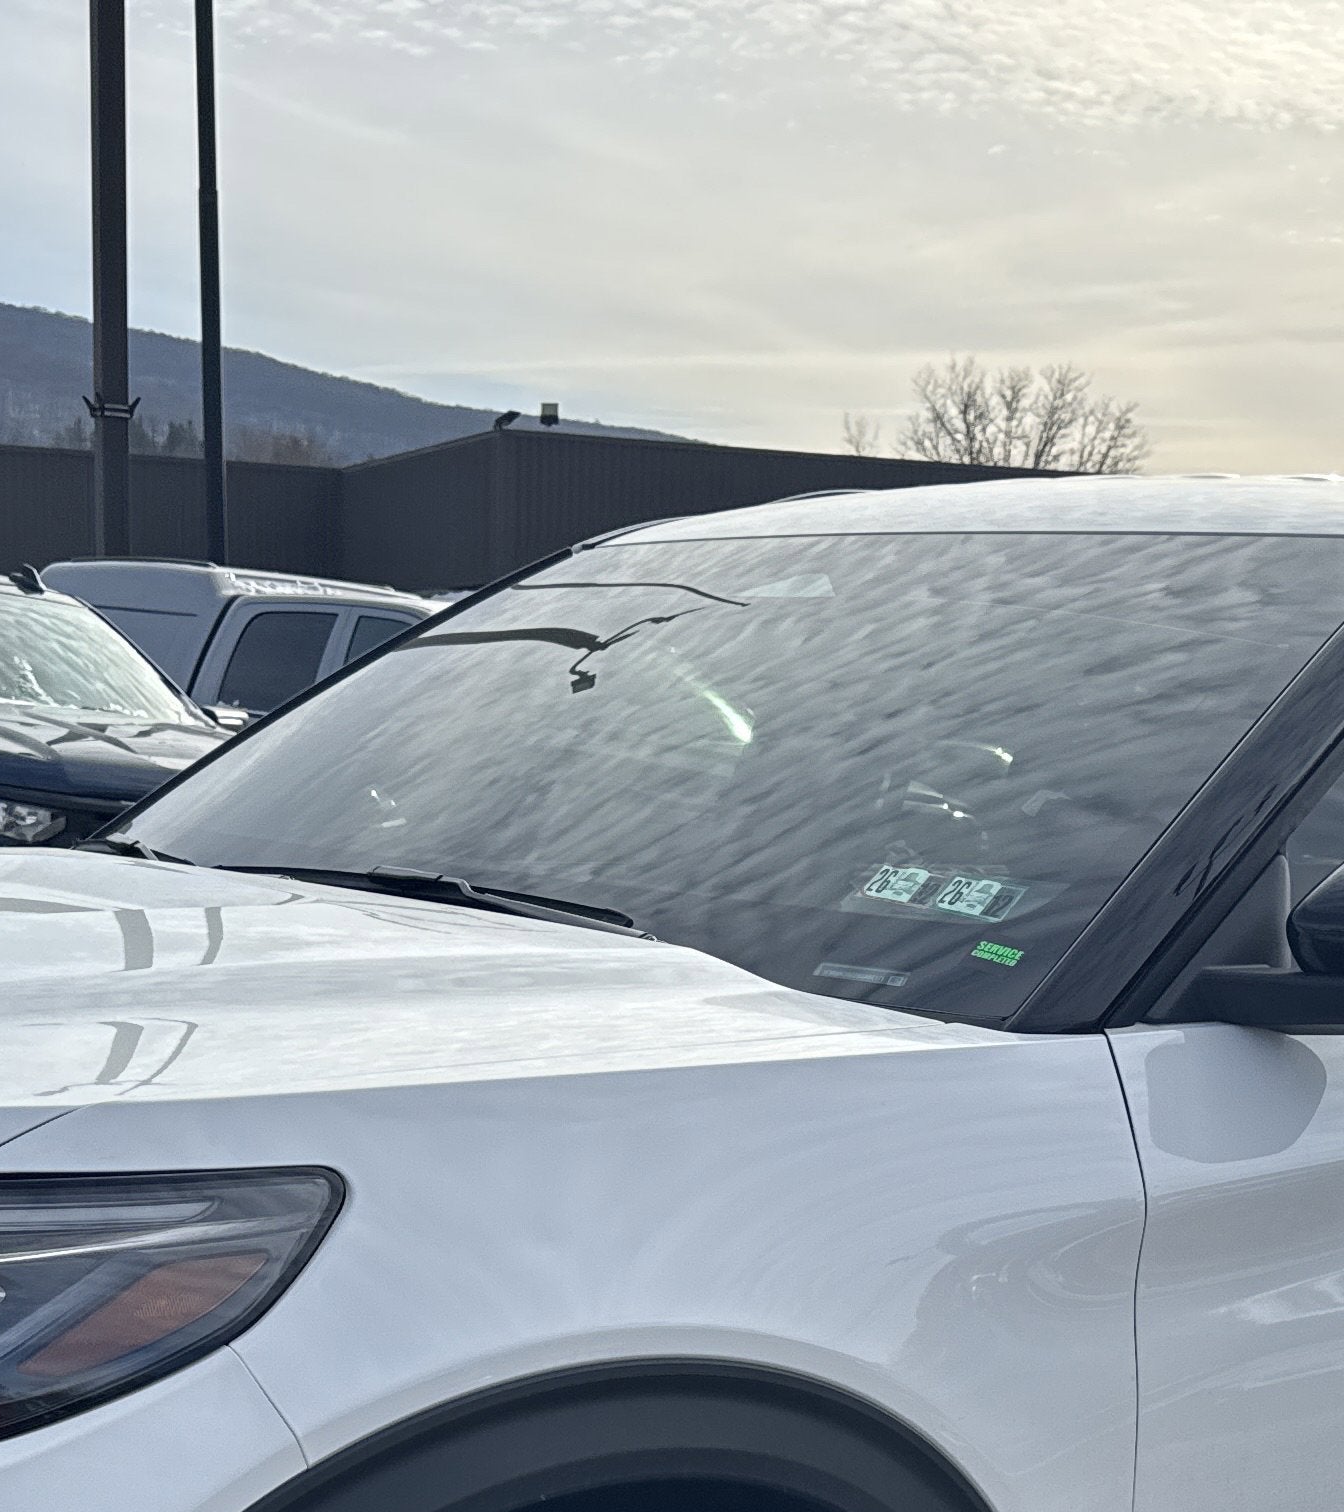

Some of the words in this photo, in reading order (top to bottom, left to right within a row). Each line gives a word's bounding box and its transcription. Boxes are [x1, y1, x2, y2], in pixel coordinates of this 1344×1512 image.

[865, 868, 899, 893] 26
[938, 880, 973, 905] 26
[971, 949, 1018, 967] COMPLETED
[976, 940, 1025, 961] SERVICE
